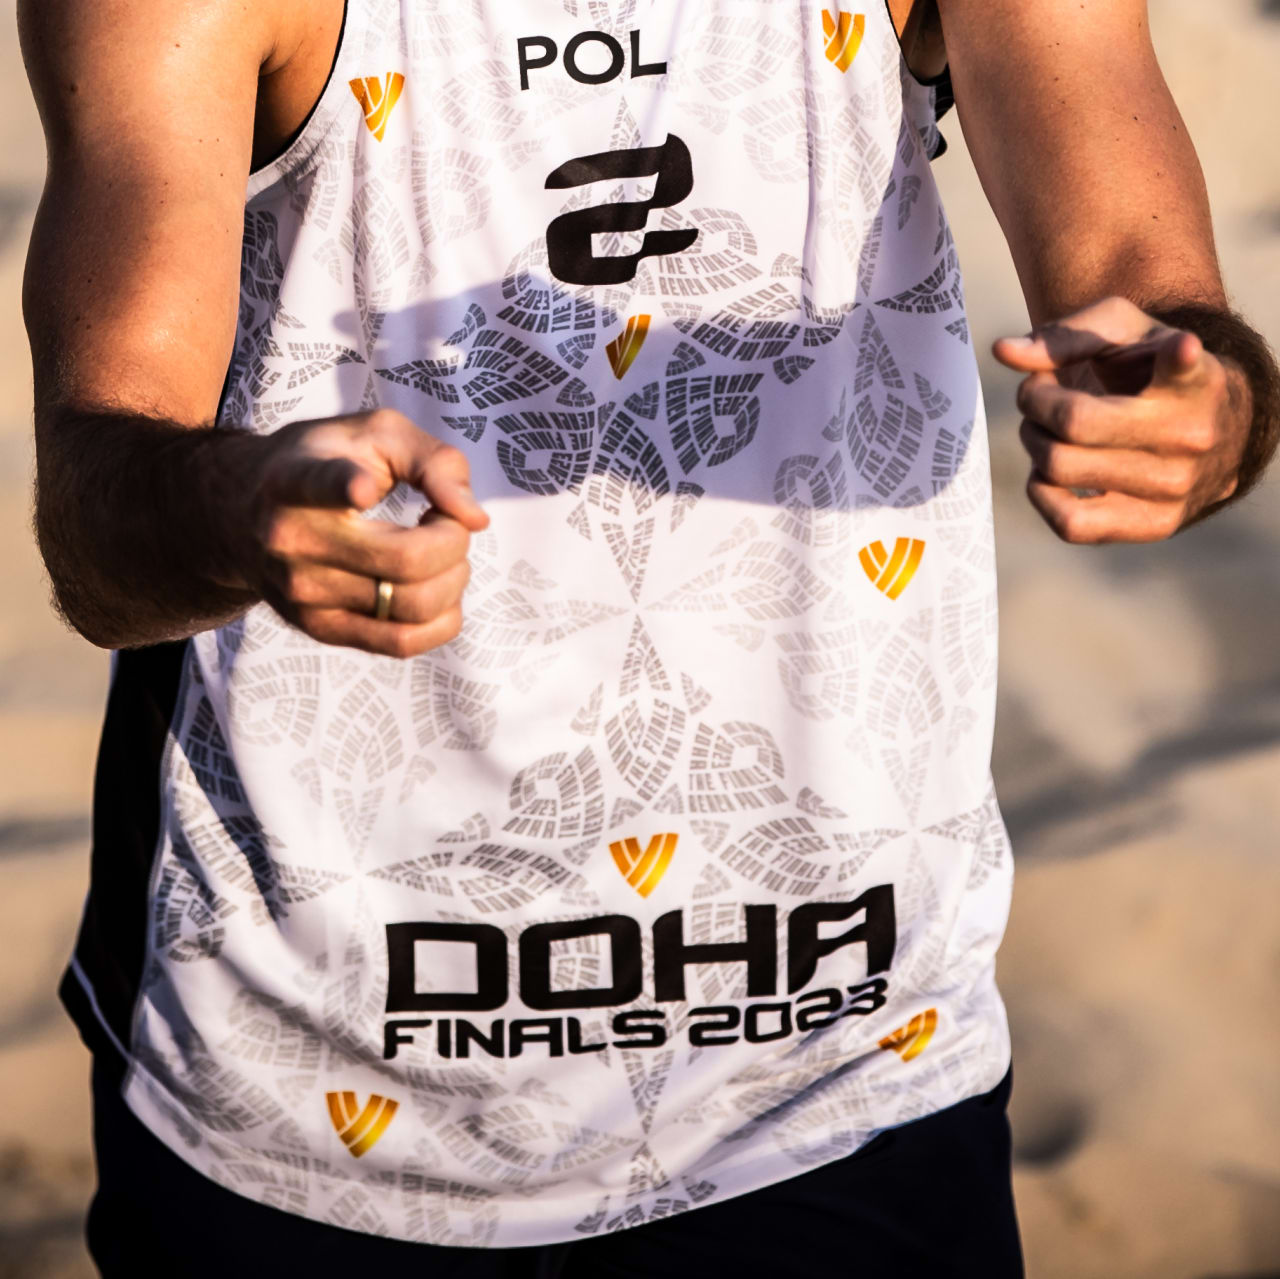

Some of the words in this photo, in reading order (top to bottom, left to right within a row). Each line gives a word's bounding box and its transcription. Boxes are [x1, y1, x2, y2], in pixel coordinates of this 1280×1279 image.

[517, 29, 667, 91] POL
[544, 133, 699, 286] 2
[385, 883, 897, 1013] DOHA
[383, 1010, 666, 1060] FINALS
[688, 977, 888, 1047] 2023
